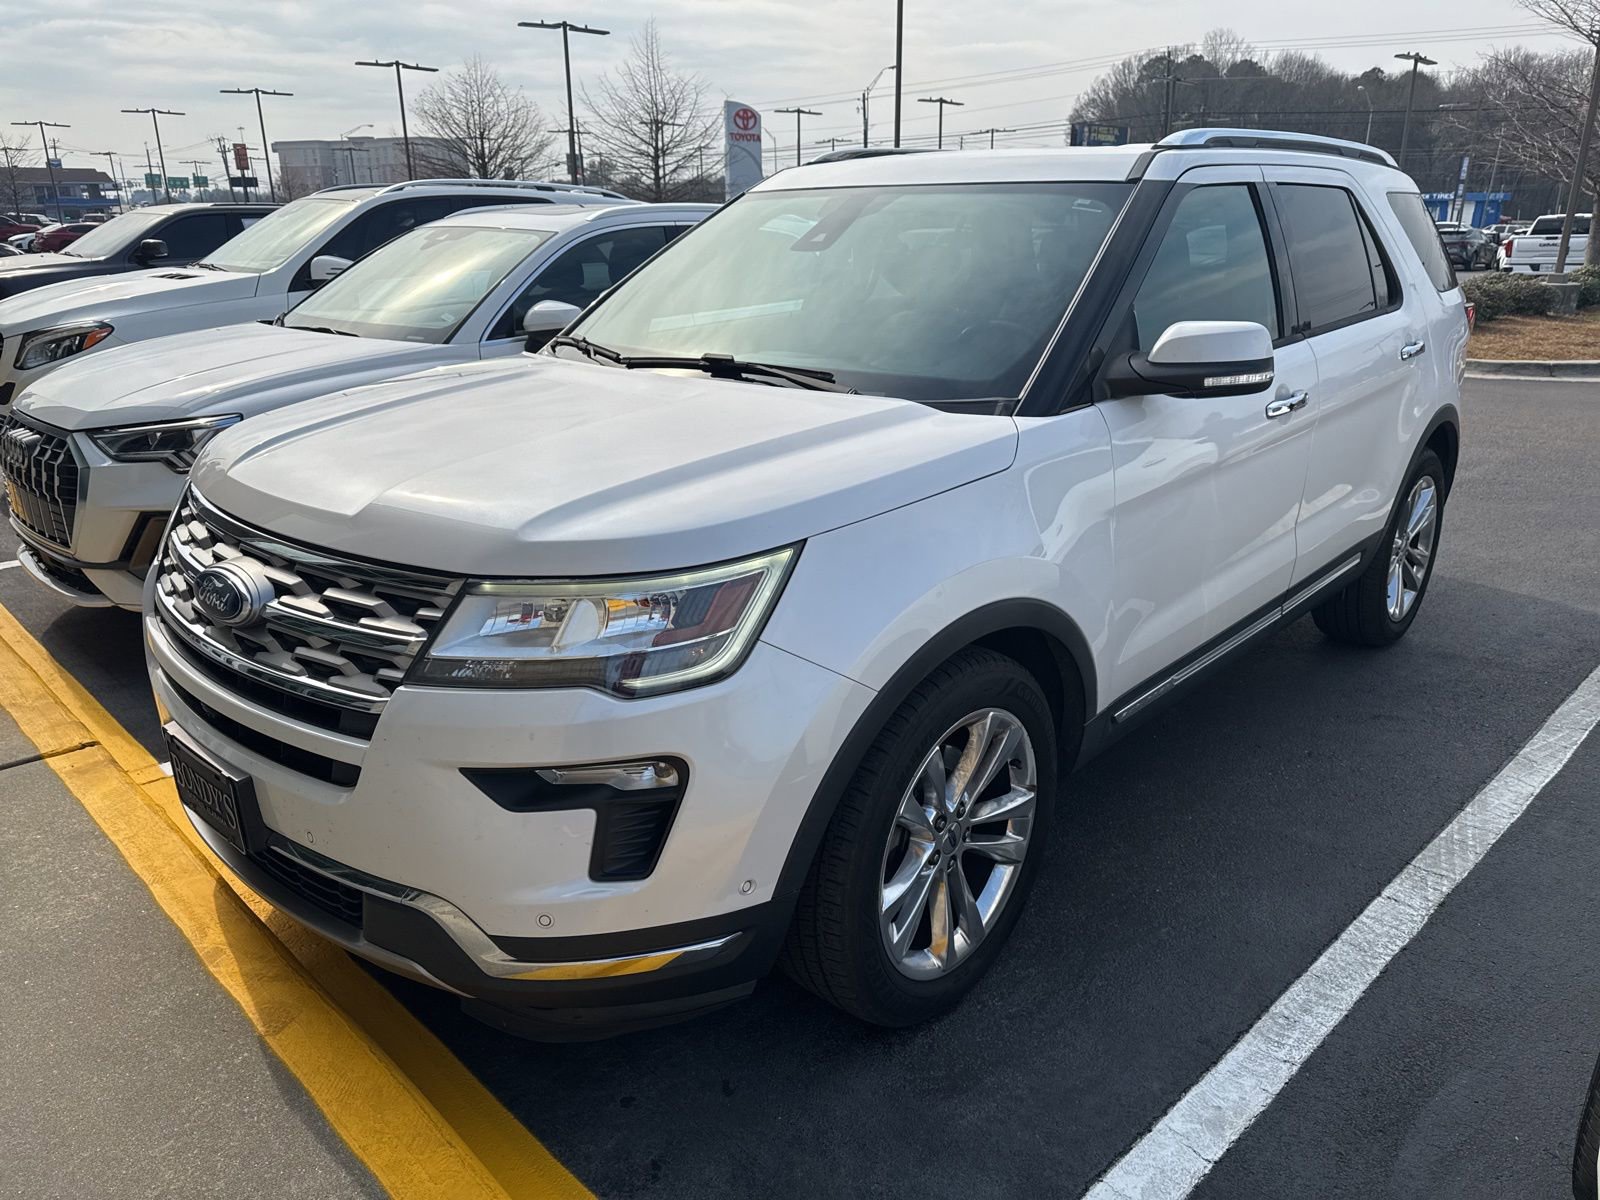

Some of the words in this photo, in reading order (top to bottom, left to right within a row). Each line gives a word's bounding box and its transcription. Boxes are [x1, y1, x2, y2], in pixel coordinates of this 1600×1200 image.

[729, 132, 761, 142] TOYOTA
[199, 576, 230, 612] Ford
[170, 752, 236, 830] BONDY'S
